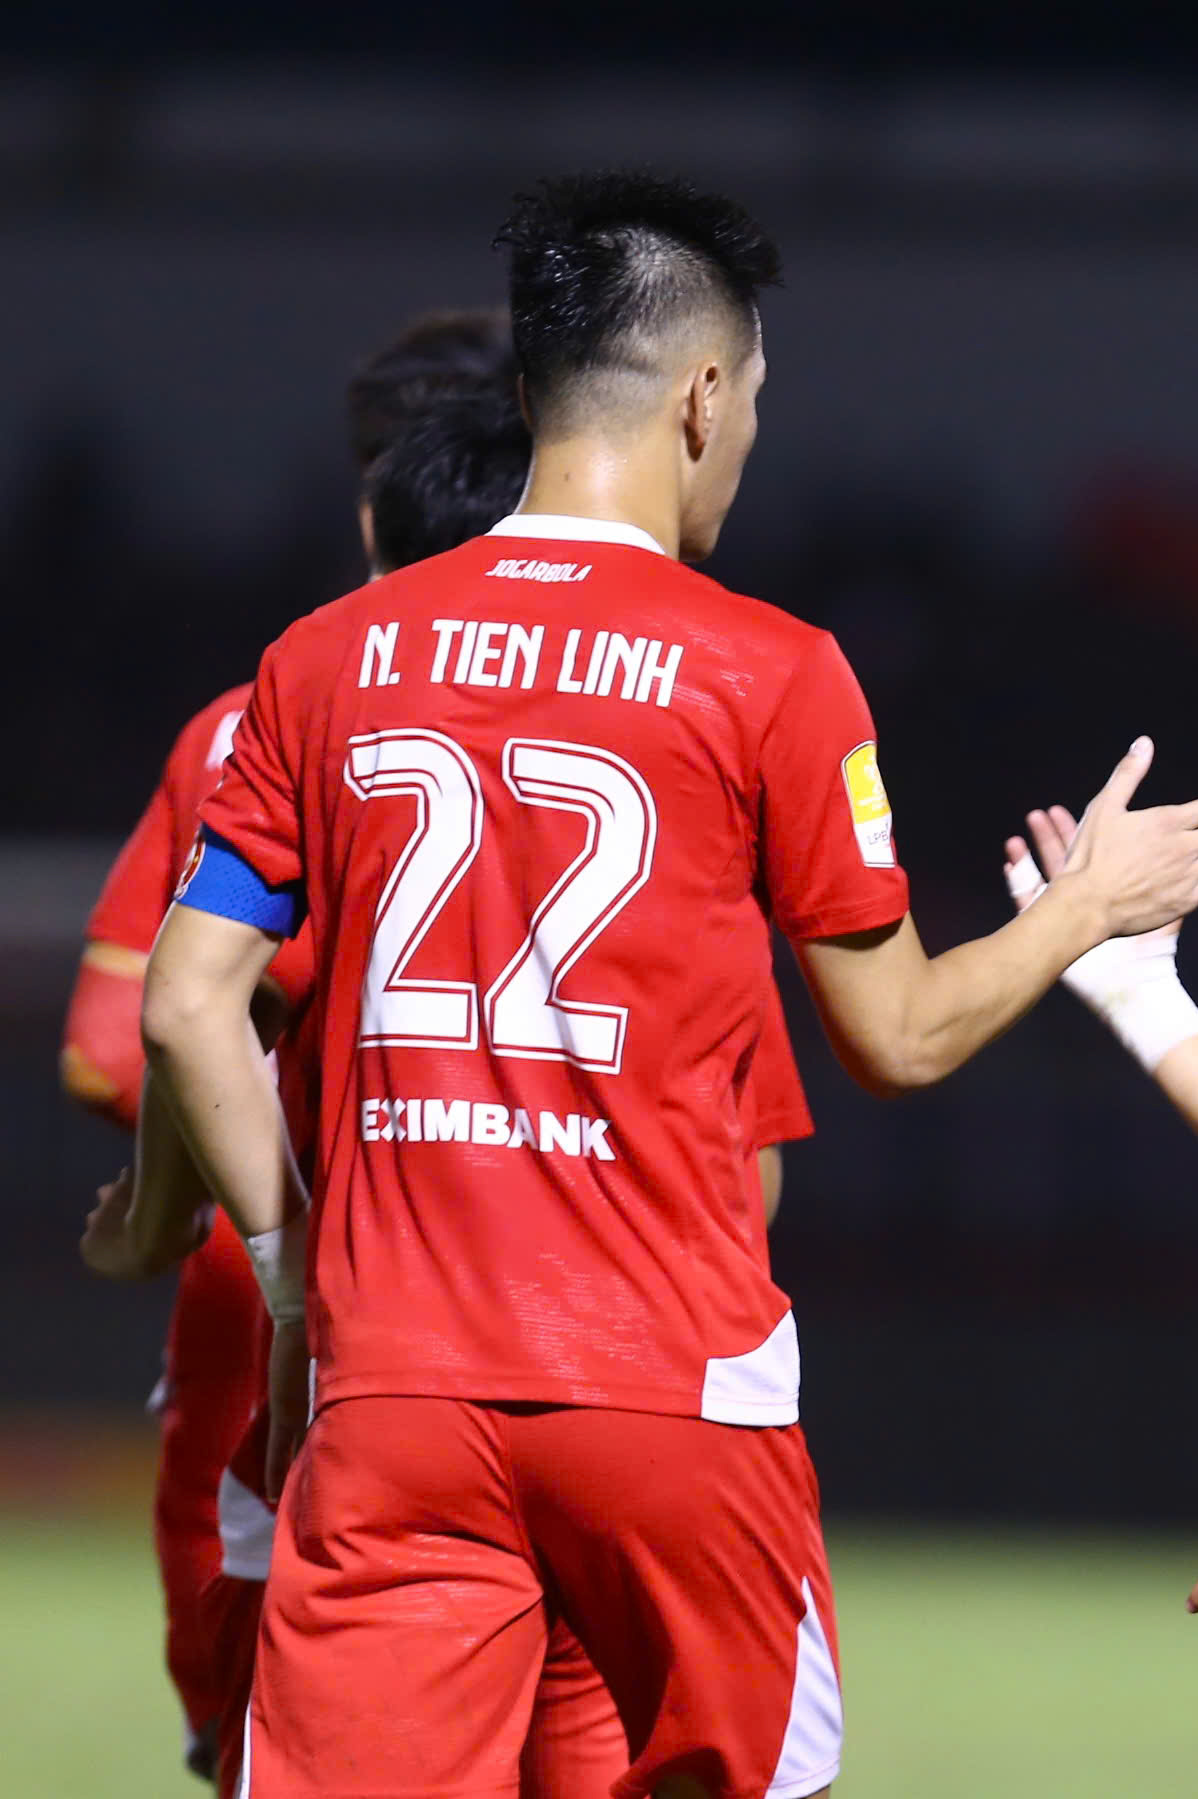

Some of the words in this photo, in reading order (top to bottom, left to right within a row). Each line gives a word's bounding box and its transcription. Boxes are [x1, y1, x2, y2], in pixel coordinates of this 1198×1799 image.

[485, 559, 593, 583] JOGARBOLA
[358, 621, 400, 688] N.
[431, 618, 545, 690] TIEN
[556, 629, 684, 707] LINH
[343, 727, 657, 1075] 22
[362, 1098, 616, 1161] EXIMBANK
